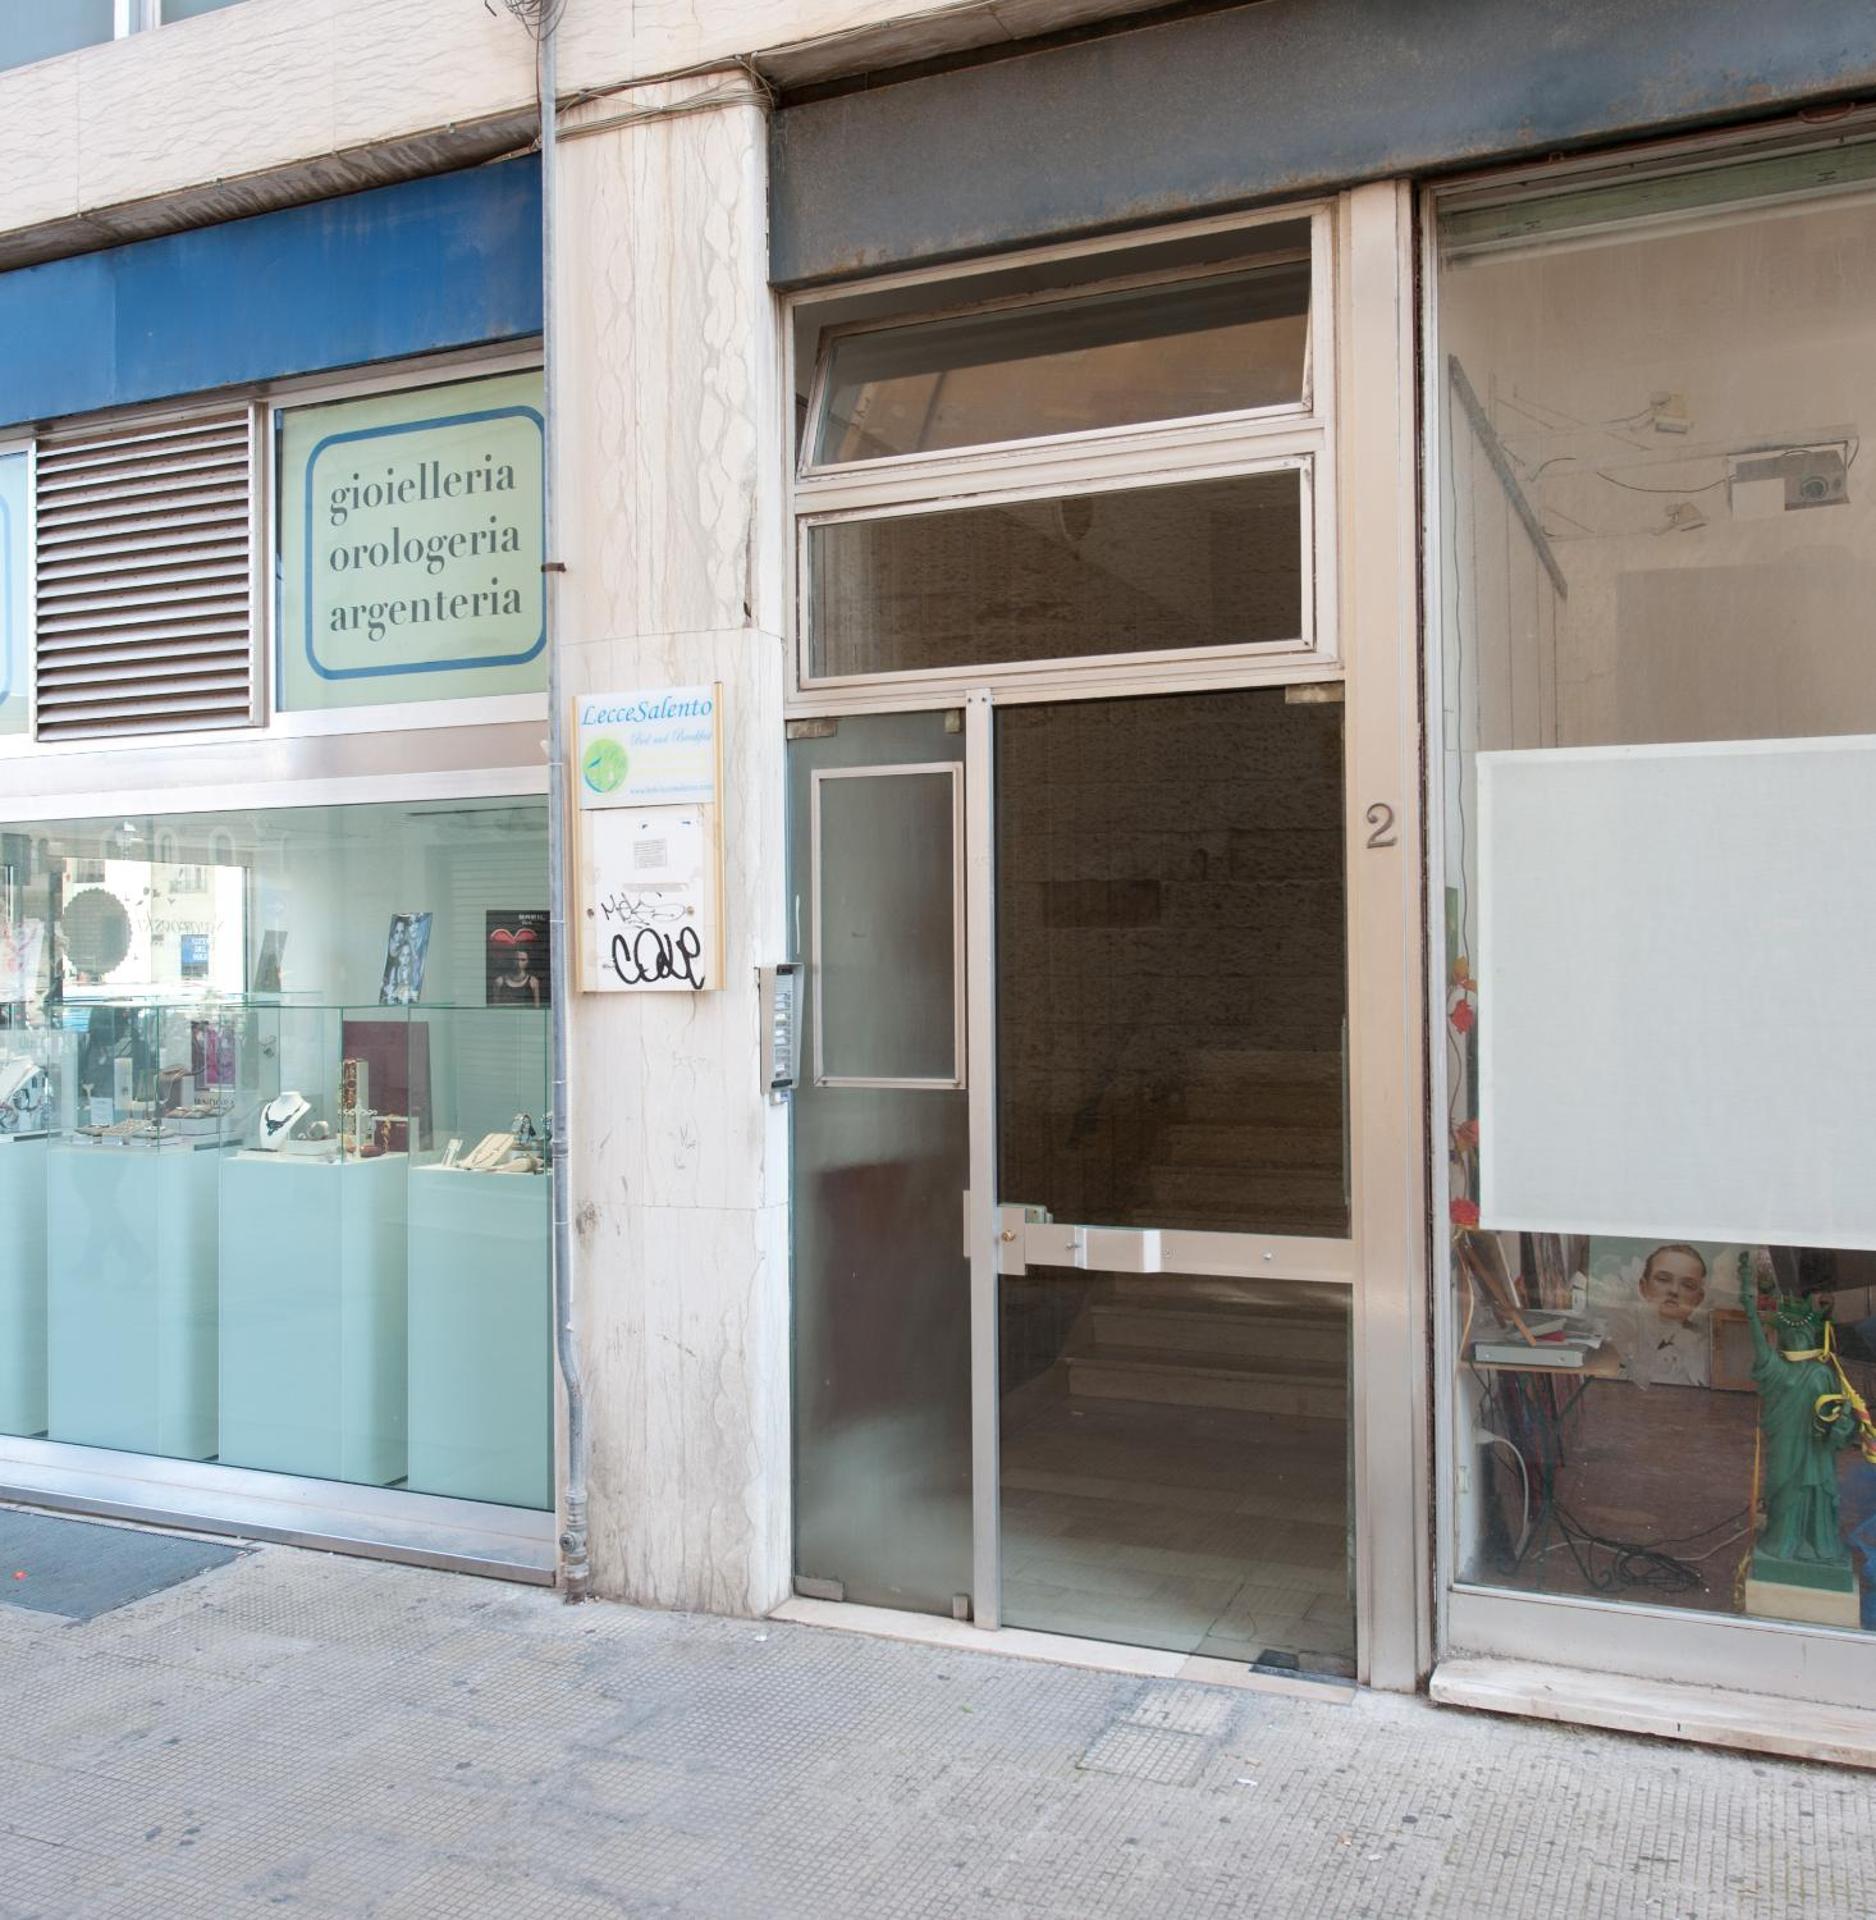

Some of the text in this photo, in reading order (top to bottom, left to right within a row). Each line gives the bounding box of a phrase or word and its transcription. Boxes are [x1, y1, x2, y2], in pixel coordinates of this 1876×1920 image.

[330, 454, 516, 526] gioielleria
[329, 515, 520, 575] orologeria
[330, 577, 522, 641] argenteria
[581, 696, 713, 725] LecceSalento
[1367, 803, 1397, 849] 2
